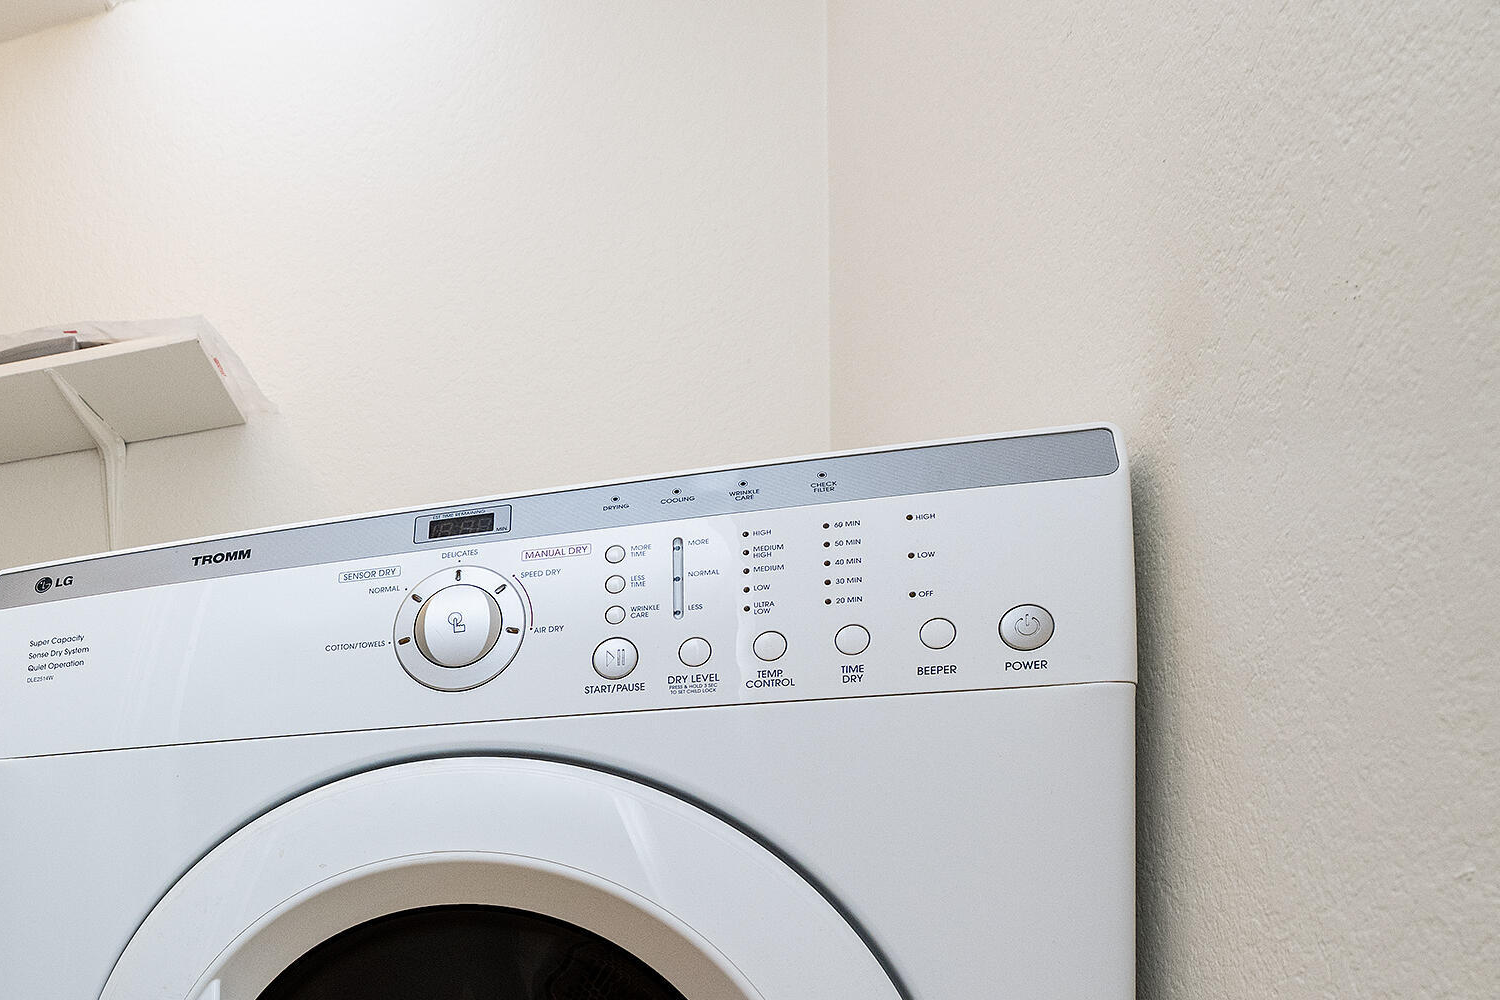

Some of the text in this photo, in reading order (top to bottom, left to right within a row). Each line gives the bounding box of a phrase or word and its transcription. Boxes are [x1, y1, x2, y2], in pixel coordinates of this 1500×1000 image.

[810, 481, 837, 489] CHECK
[729, 489, 760, 497] WRINKLE
[660, 495, 696, 505] COOLING
[734, 494, 754, 502] CARE
[603, 503, 630, 512] DRYING
[915, 513, 936, 521] HIGH
[834, 520, 861, 529] 60 MIN
[752, 529, 772, 537] HIGH
[687, 538, 710, 546] MORE
[845, 538, 862, 546] MIN
[630, 544, 652, 552] MORE
[752, 543, 784, 552] MEDIUM
[192, 548, 252, 566] TROMM
[441, 548, 479, 559] DELICATES
[525, 545, 589, 560] MANUAL DRY
[630, 550, 647, 558] TIME
[753, 551, 772, 559] HIGH
[917, 551, 936, 559] LOW
[835, 557, 862, 566] 40 MIN
[687, 568, 720, 577] NORMAL
[753, 564, 785, 573] MEDIUM
[343, 568, 397, 581] SENSOR DRY
[520, 568, 561, 579] SPEED DRY
[630, 574, 646, 582] LESS
[55, 575, 74, 588] LG
[630, 580, 647, 588] TIME
[835, 576, 863, 585] 30 MIN
[368, 585, 401, 595] NORMAL
[753, 583, 771, 591] LOW
[918, 590, 934, 598] OFF
[630, 604, 660, 612] WRINKLE
[687, 603, 703, 611] LESS
[753, 600, 775, 608] ULTRA
[630, 611, 649, 619] CARE
[753, 607, 771, 615] LOW
[533, 625, 565, 634] AIR DRY
[29, 634, 85, 648] Super Capacity
[325, 640, 386, 652] COTTON/TOWELS
[28, 647, 90, 660] Sense Dry System
[28, 660, 85, 672] Quiet Operation
[841, 664, 865, 674] TIME
[1005, 659, 1048, 671] POWER
[917, 664, 957, 676] BEEPER
[667, 673, 720, 684] DRY LEVEL
[842, 673, 864, 683] DRY
[745, 678, 795, 689] CONTROL
[584, 682, 646, 695] START/PAUSE
